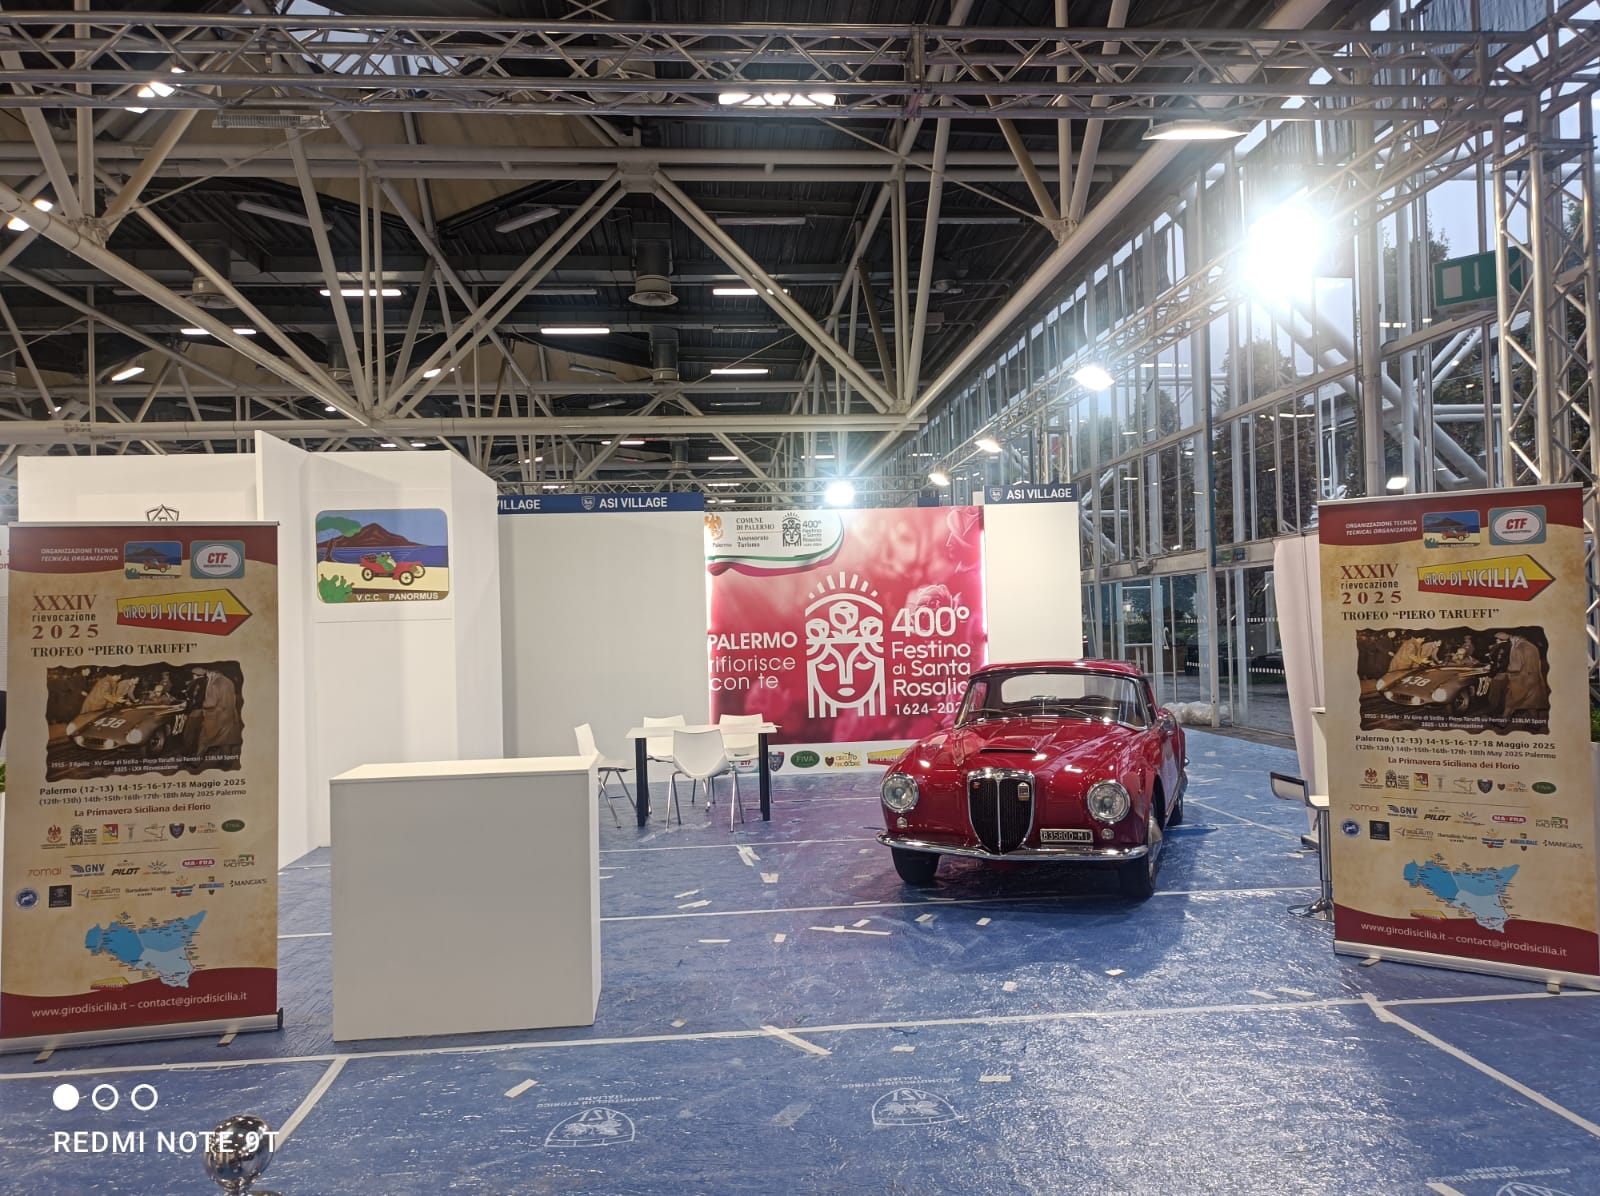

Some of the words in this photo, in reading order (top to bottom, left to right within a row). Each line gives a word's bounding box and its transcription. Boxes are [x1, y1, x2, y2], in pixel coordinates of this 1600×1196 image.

[1006, 489, 1025, 500] ASI
[1027, 488, 1073, 499] VILLAGE
[600, 498, 618, 509] ASI
[621, 497, 668, 508] VILLAGE
[744, 523, 775, 531] PALERMO
[1505, 518, 1529, 530] CTF
[207, 552, 229, 564] CTF
[1340, 563, 1399, 580] XXXIV
[1423, 571, 1447, 587] GIRO
[1450, 570, 1463, 587] DI
[1465, 566, 1529, 589] SICILIA
[1340, 580, 1399, 590] rievocazione
[388, 592, 439, 601] PANORMUS
[31, 594, 98, 612] XXXIV
[31, 612, 97, 623] rievocazione
[122, 603, 147, 619] GIRO
[150, 603, 163, 619] DI
[166, 600, 228, 624] SICILIA
[1341, 610, 1389, 621] TROFEO
[707, 631, 798, 651] PALERMO
[31, 645, 84, 658] TROFEO
[891, 638, 971, 659] Festino
[910, 658, 971, 678] Santa
[710, 676, 751, 692] con
[758, 672, 779, 690] te
[1401, 675, 1430, 687] 438
[94, 717, 126, 729] 438
[1355, 735, 1390, 743] Palermo
[1391, 735, 1423, 745] (12-13)
[1496, 740, 1530, 750] Maggio
[1532, 742, 1556, 750] 2025
[796, 755, 815, 763] FIVA
[1486, 750, 1503, 758] May
[1524, 751, 1557, 759] Palermo
[1388, 756, 1397, 764] La
[1398, 757, 1441, 766] Primavera
[1442, 759, 1478, 768] Siciliana
[1479, 761, 1494, 769] dei
[1495, 762, 1520, 770] Florio
[39, 787, 77, 796] Palermo
[79, 784, 114, 795] (12-13)
[189, 779, 221, 789] Maggio
[223, 778, 246, 787] 2025
[180, 791, 195, 799] May
[215, 788, 247, 796] Palermo
[74, 809, 84, 817] La
[86, 807, 133, 816] Primavera
[134, 804, 171, 814] Siciliana
[172, 803, 186, 812] dei
[188, 802, 211, 811] Florio
[1400, 806, 1418, 815] GNV
[1423, 813, 1452, 821] PILOT
[85, 863, 105, 873] GNV
[111, 867, 141, 876] PILOT
[1360, 921, 1447, 942] www.girodisicilia.it
[1455, 934, 1568, 957] contact@girodisicilia.it
[31, 1001, 127, 1018] www.girodisicilia.it
[137, 991, 248, 1009] contact@girodisicilia.it
